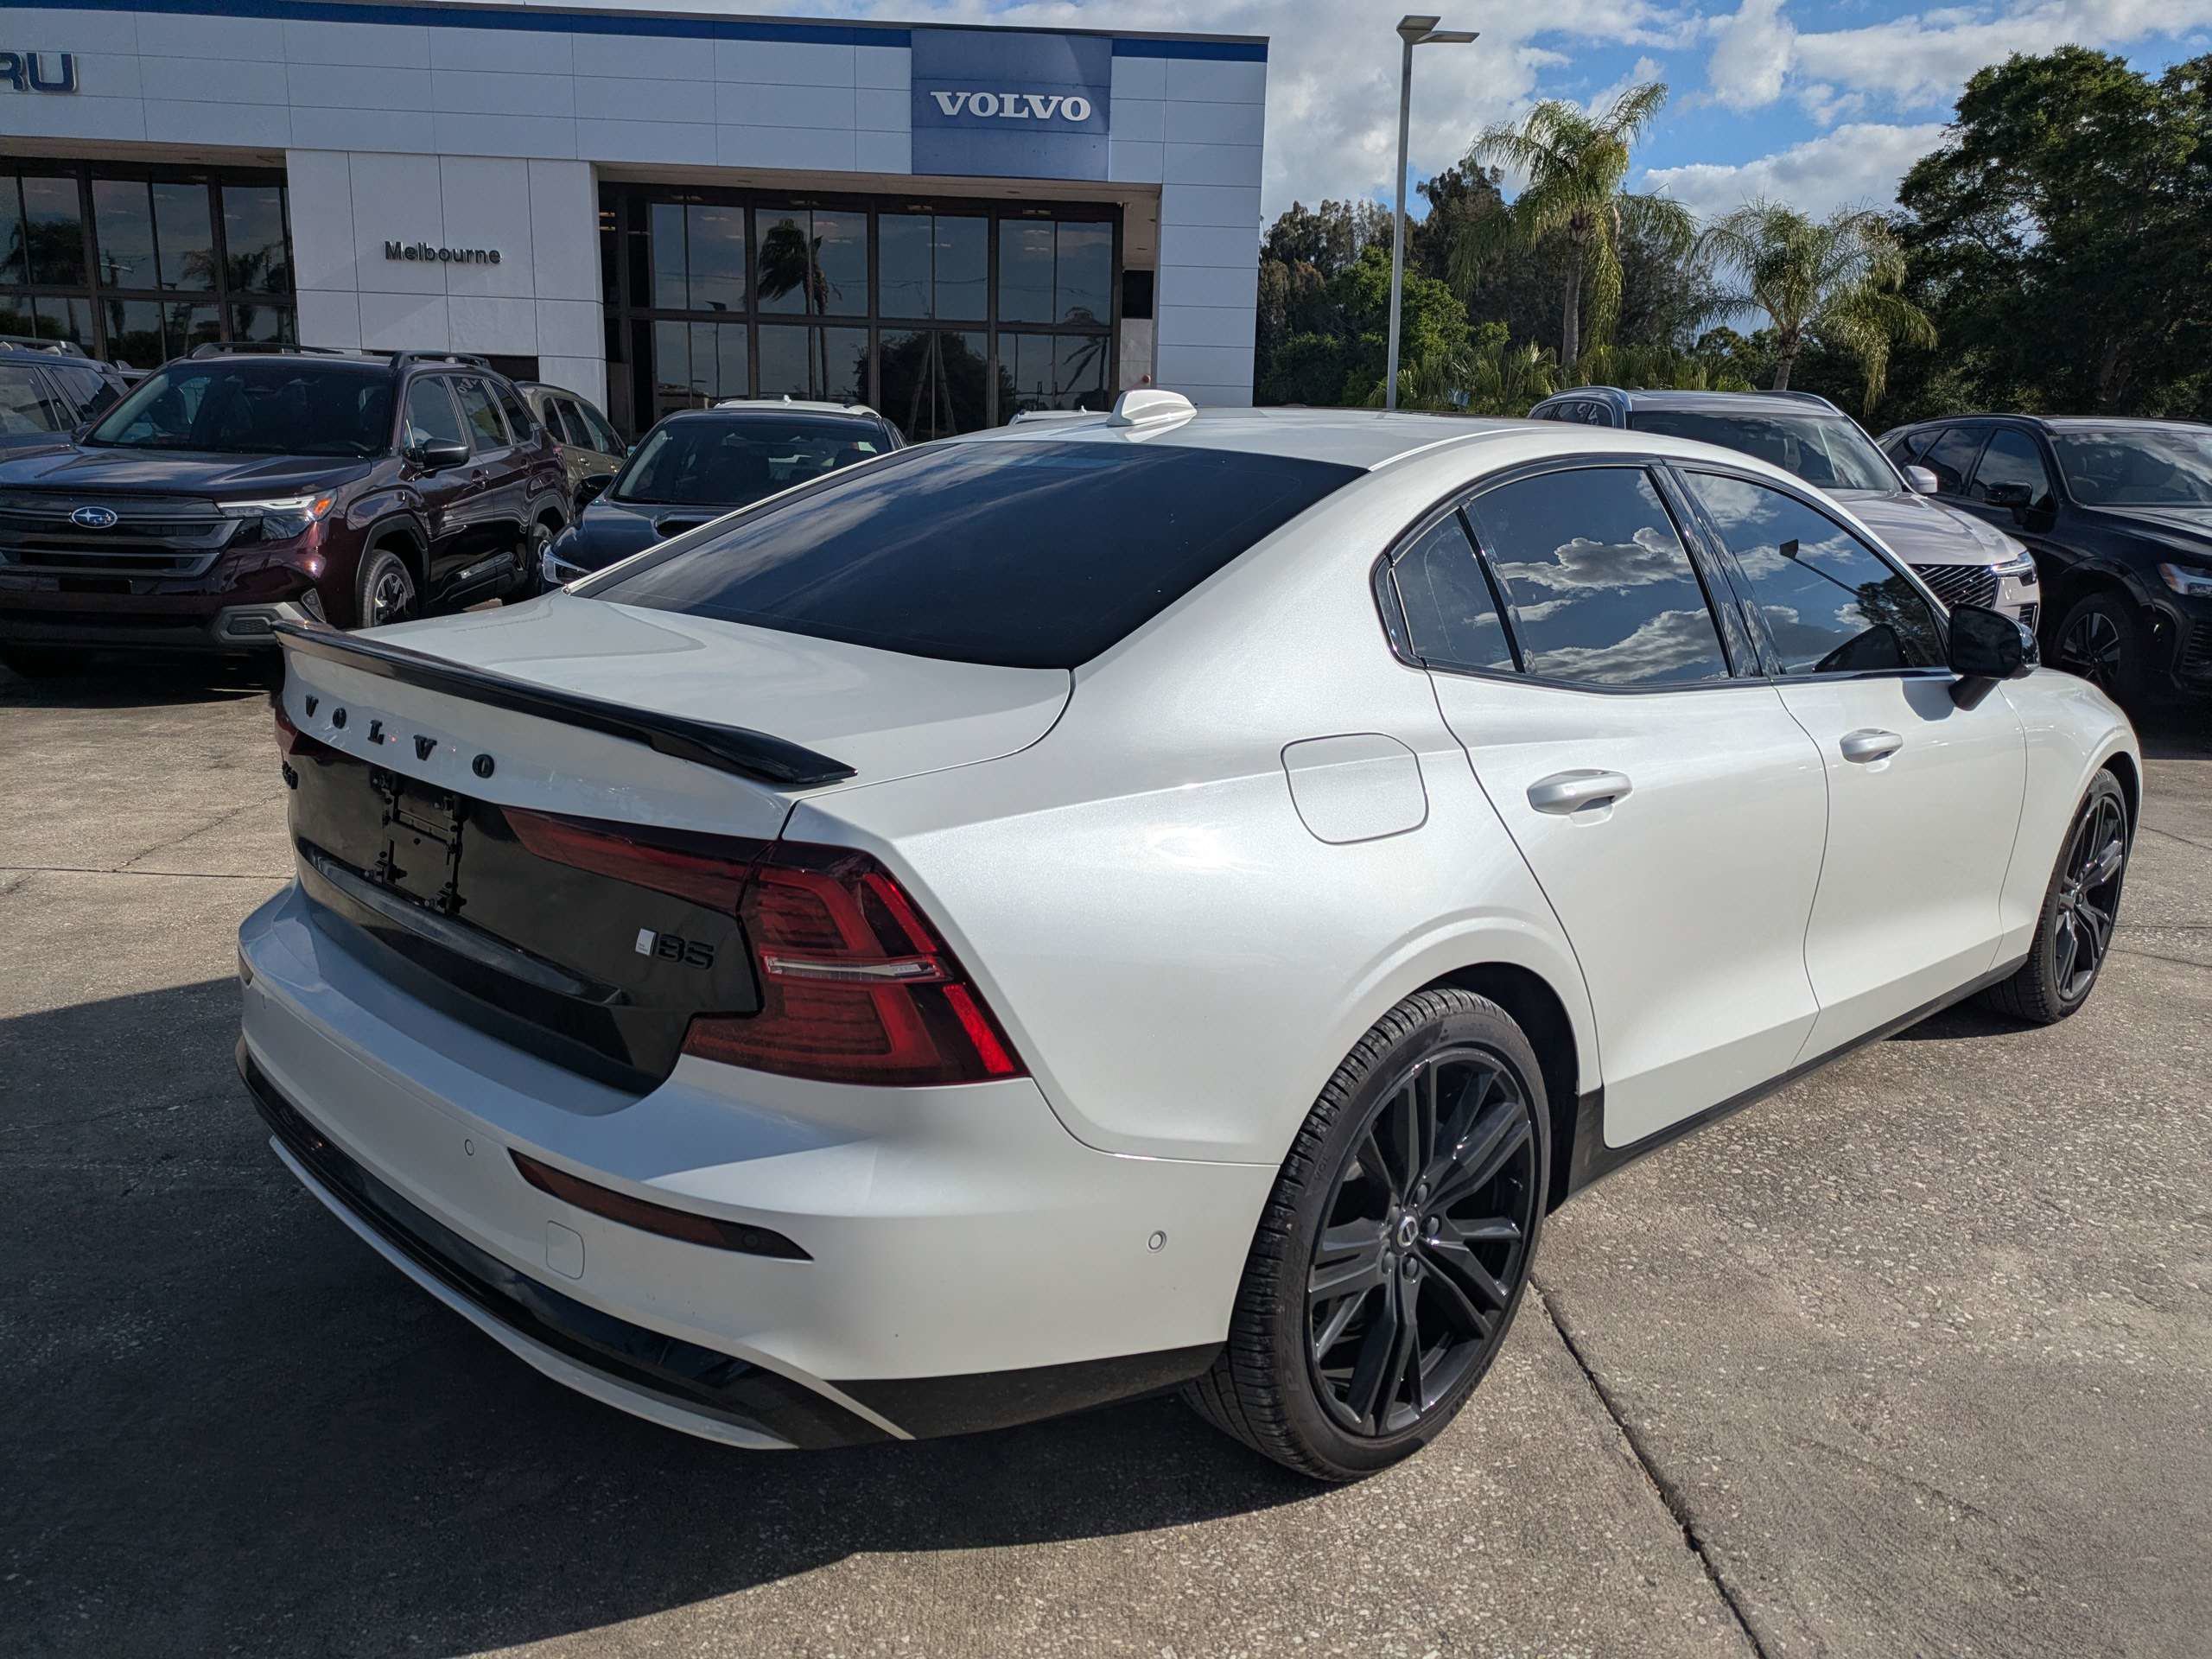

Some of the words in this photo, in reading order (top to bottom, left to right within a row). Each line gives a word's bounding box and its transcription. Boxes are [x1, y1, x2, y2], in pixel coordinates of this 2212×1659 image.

[931, 91, 1091, 121] VOLVO
[385, 241, 503, 264] Melbourne
[305, 694, 495, 779] VOLVO
[656, 933, 715, 969] B5
